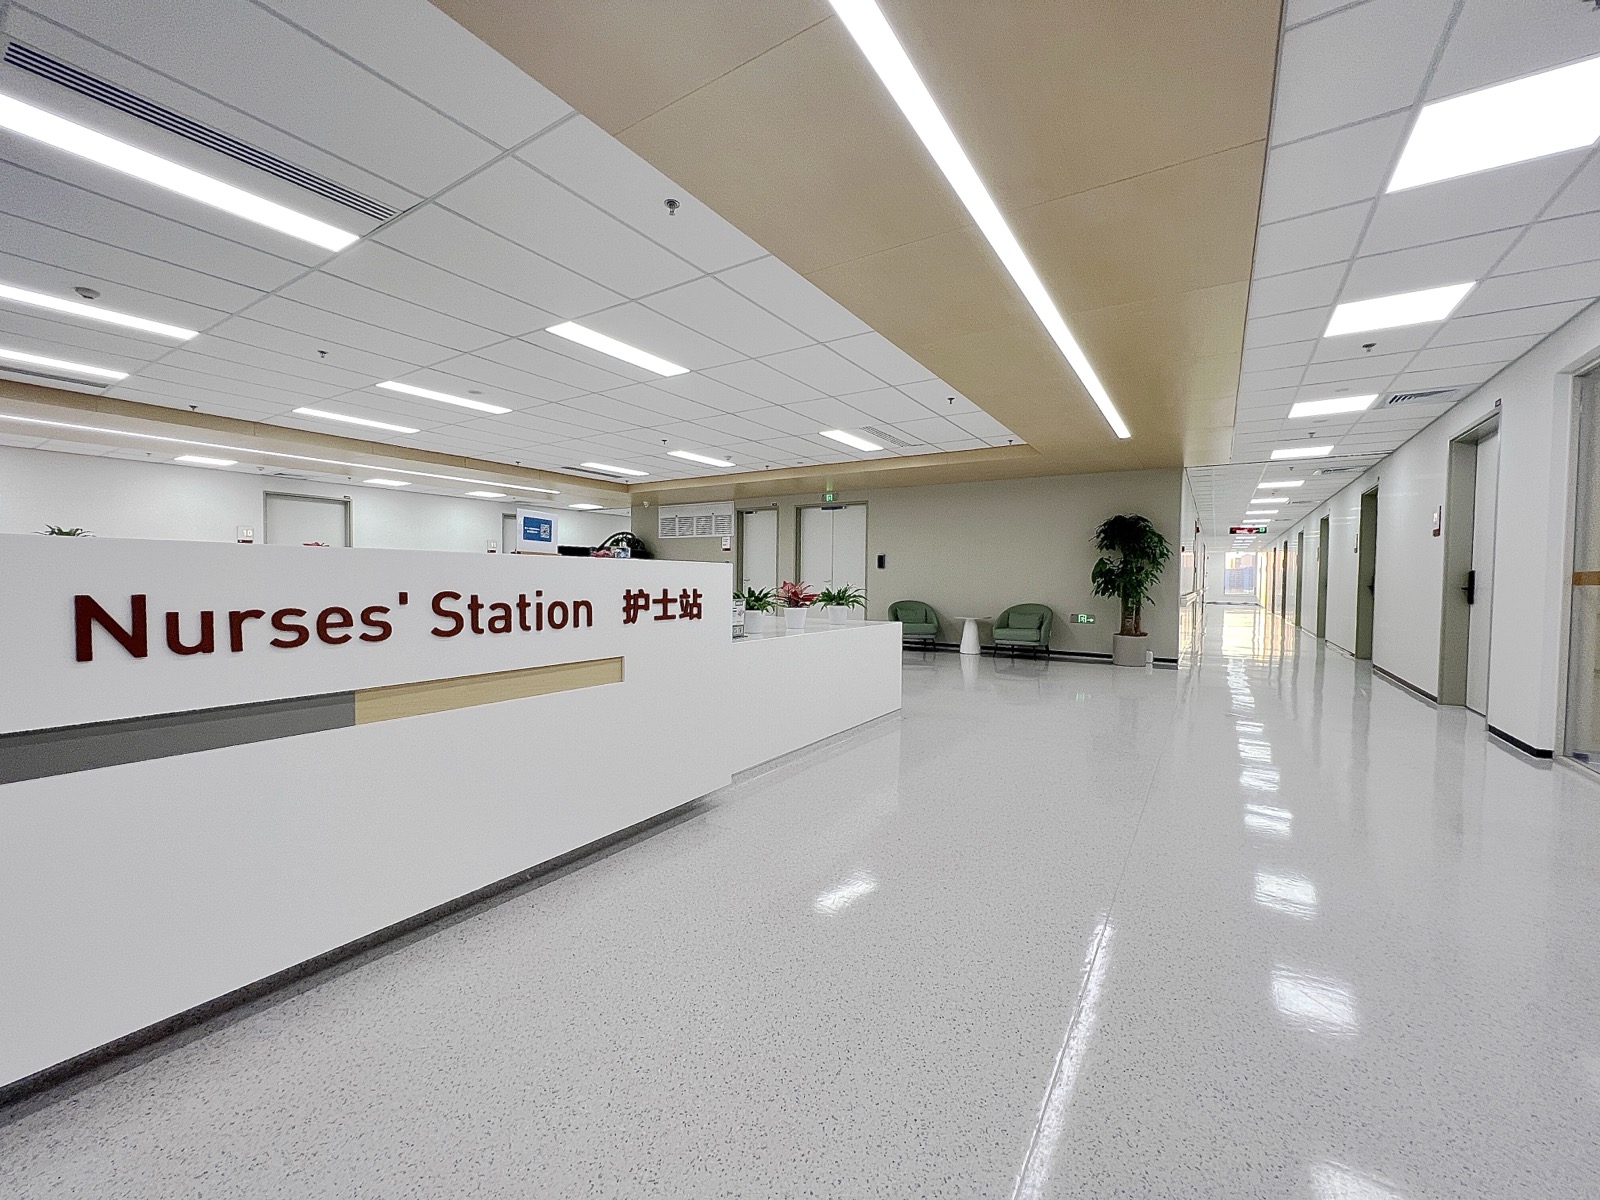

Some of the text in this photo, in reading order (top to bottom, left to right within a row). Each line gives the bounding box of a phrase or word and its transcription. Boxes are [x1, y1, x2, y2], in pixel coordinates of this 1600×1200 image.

[243, 529, 252, 537] 10
[75, 588, 703, 661] Nurses' Station 护士站
